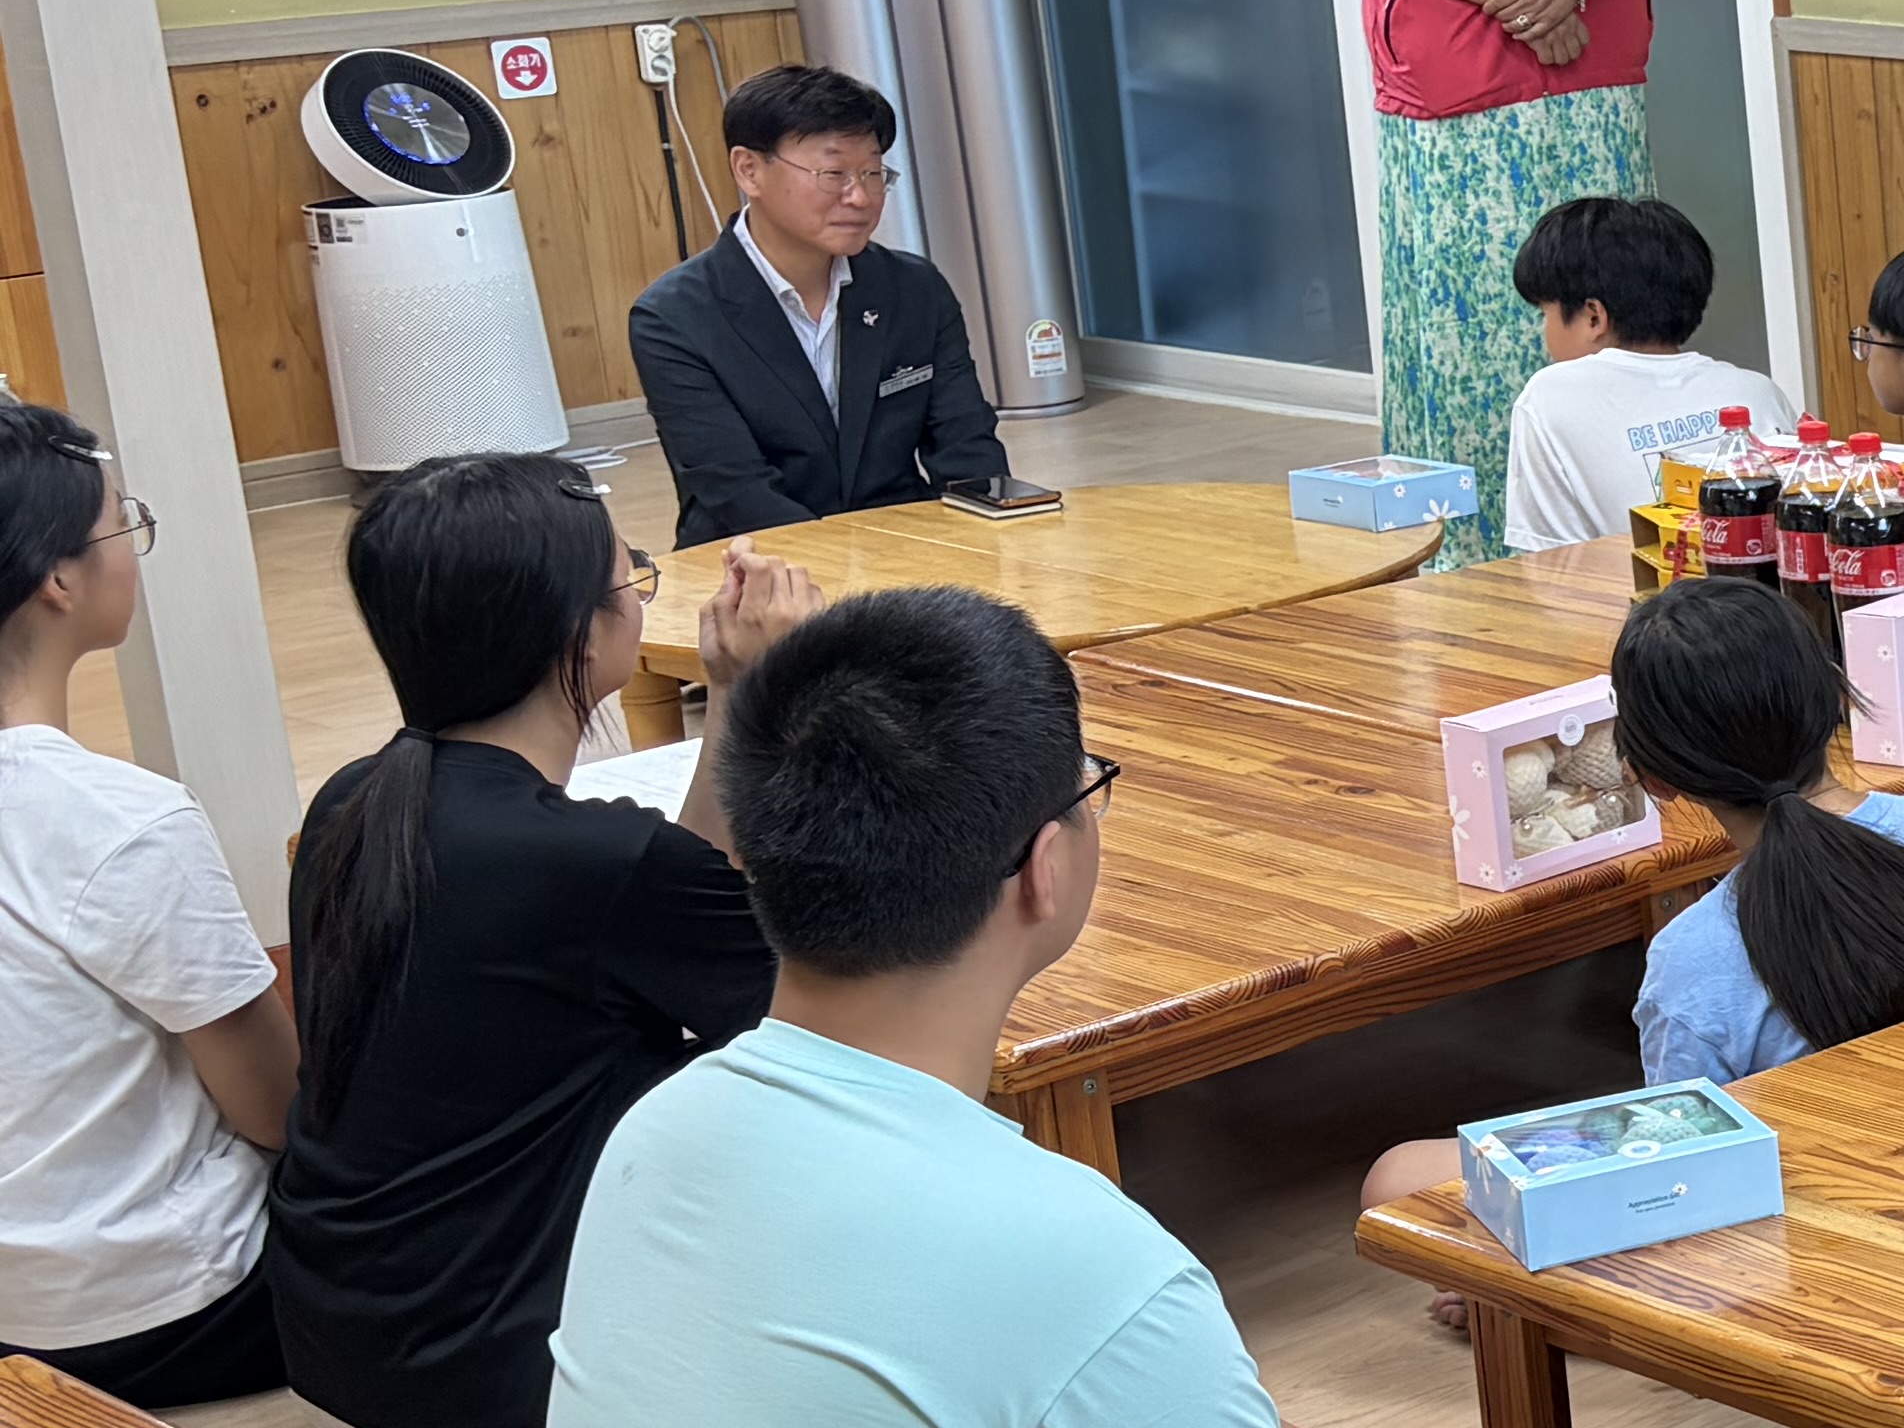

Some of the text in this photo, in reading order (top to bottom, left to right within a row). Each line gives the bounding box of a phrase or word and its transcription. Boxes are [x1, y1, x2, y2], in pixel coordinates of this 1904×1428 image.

[505, 53, 543, 69] 소화기
[1628, 408, 1719, 453] BE HAPP
[1703, 518, 1730, 545] ola
